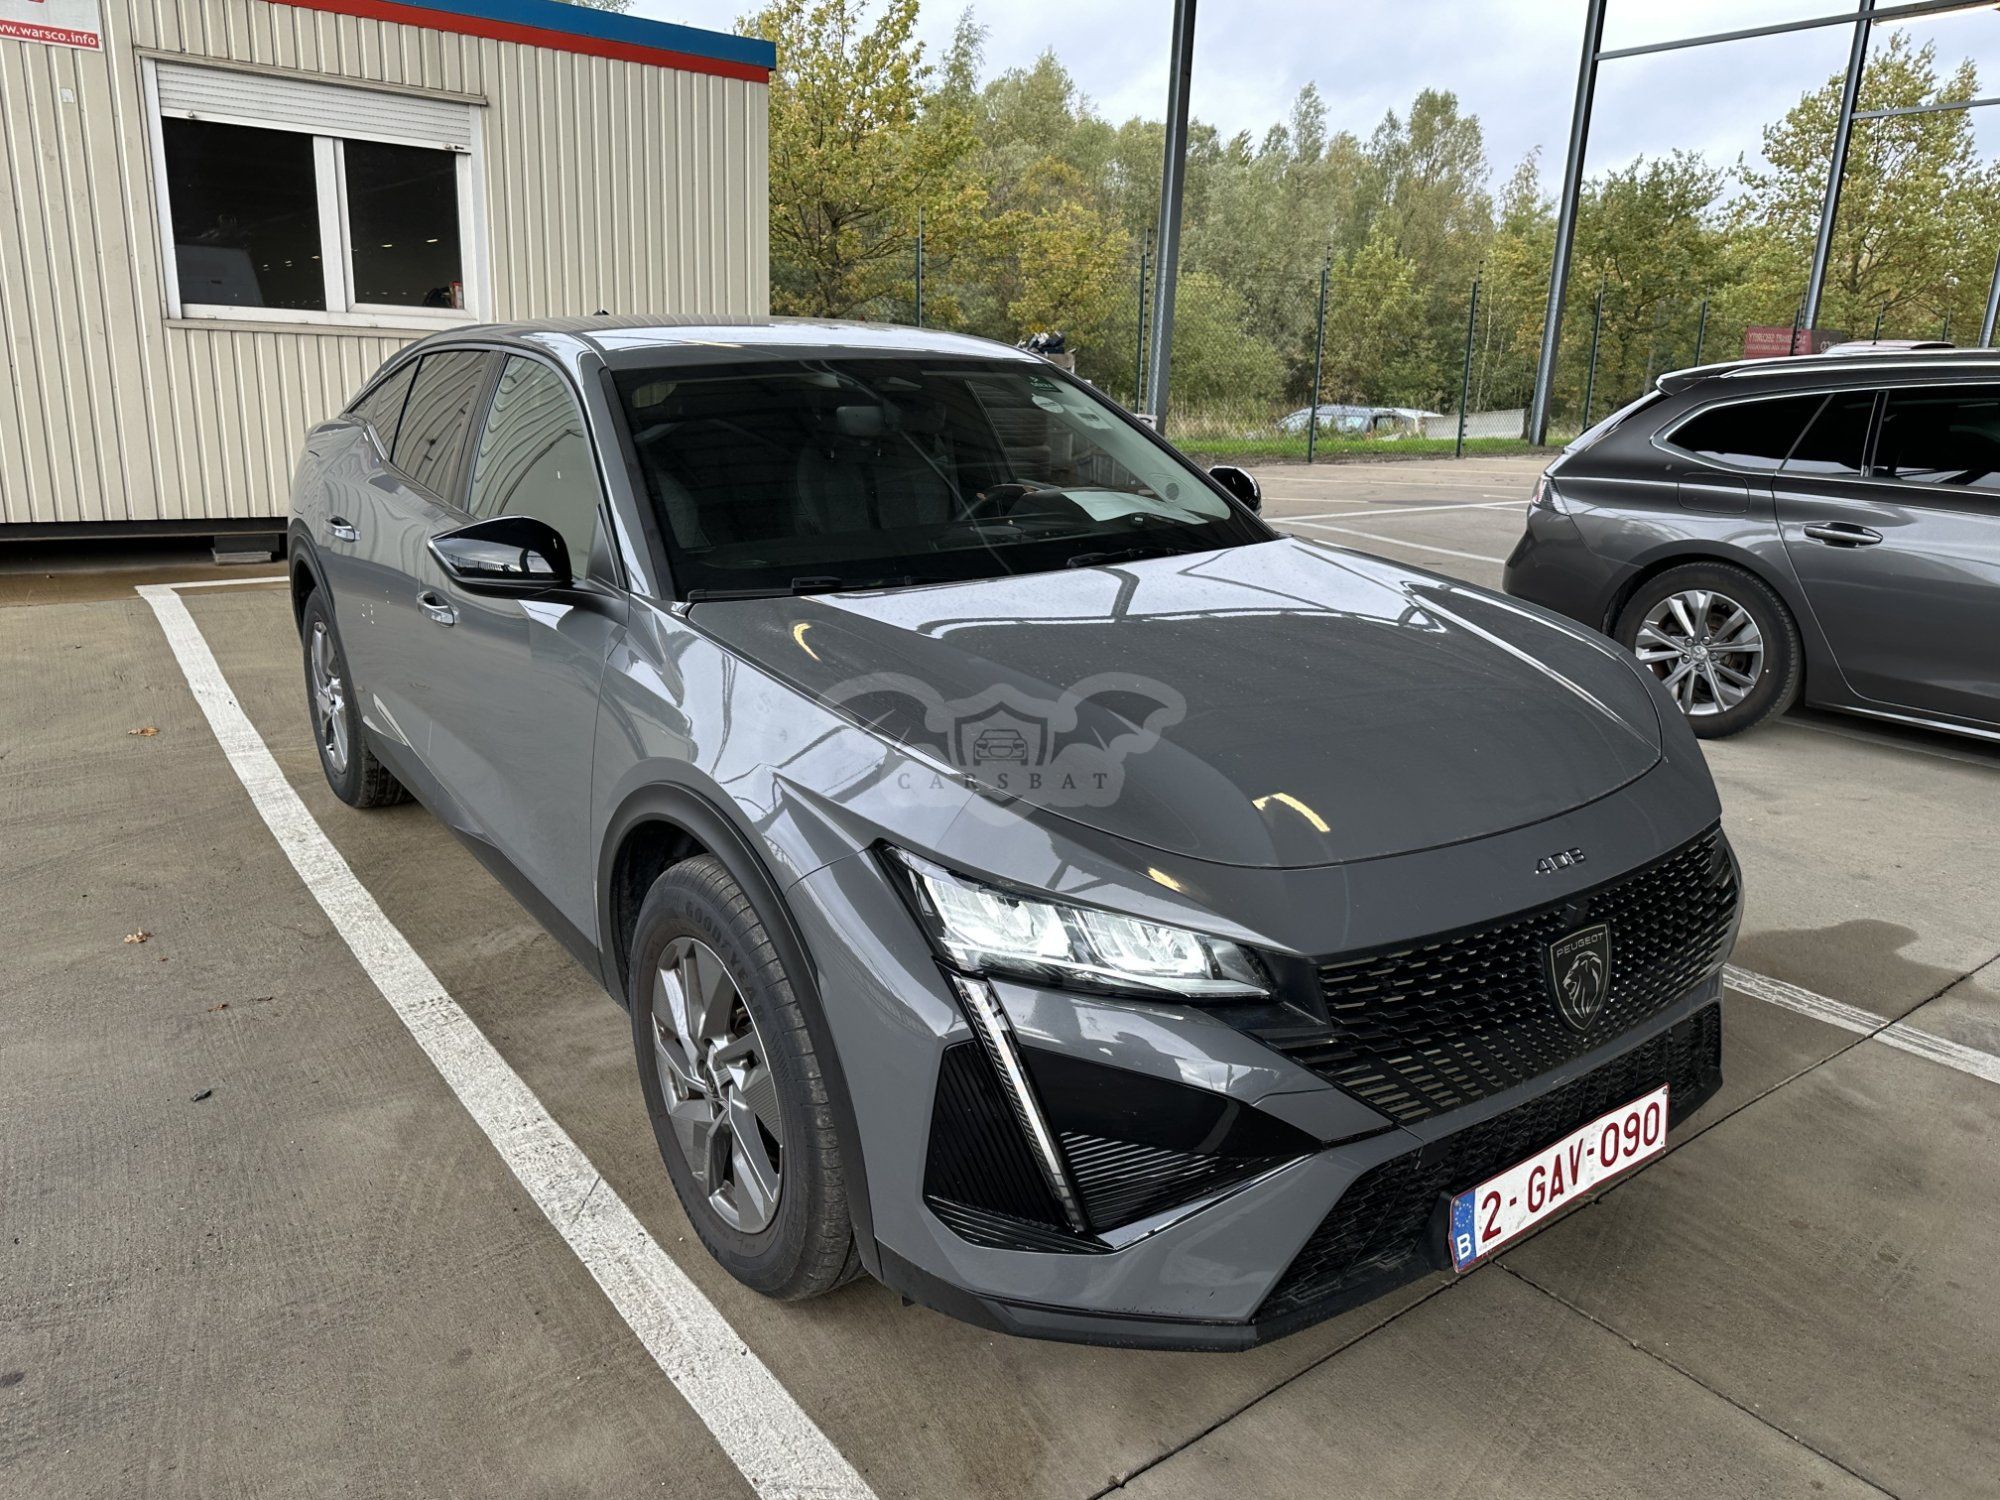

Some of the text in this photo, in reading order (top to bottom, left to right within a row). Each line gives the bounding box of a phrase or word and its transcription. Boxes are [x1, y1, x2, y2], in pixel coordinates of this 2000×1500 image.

[1556, 932, 1605, 958] PEUGEOT
[1481, 1101, 1660, 1243] 2-GAV-090
[1456, 1233, 1472, 1261] B
